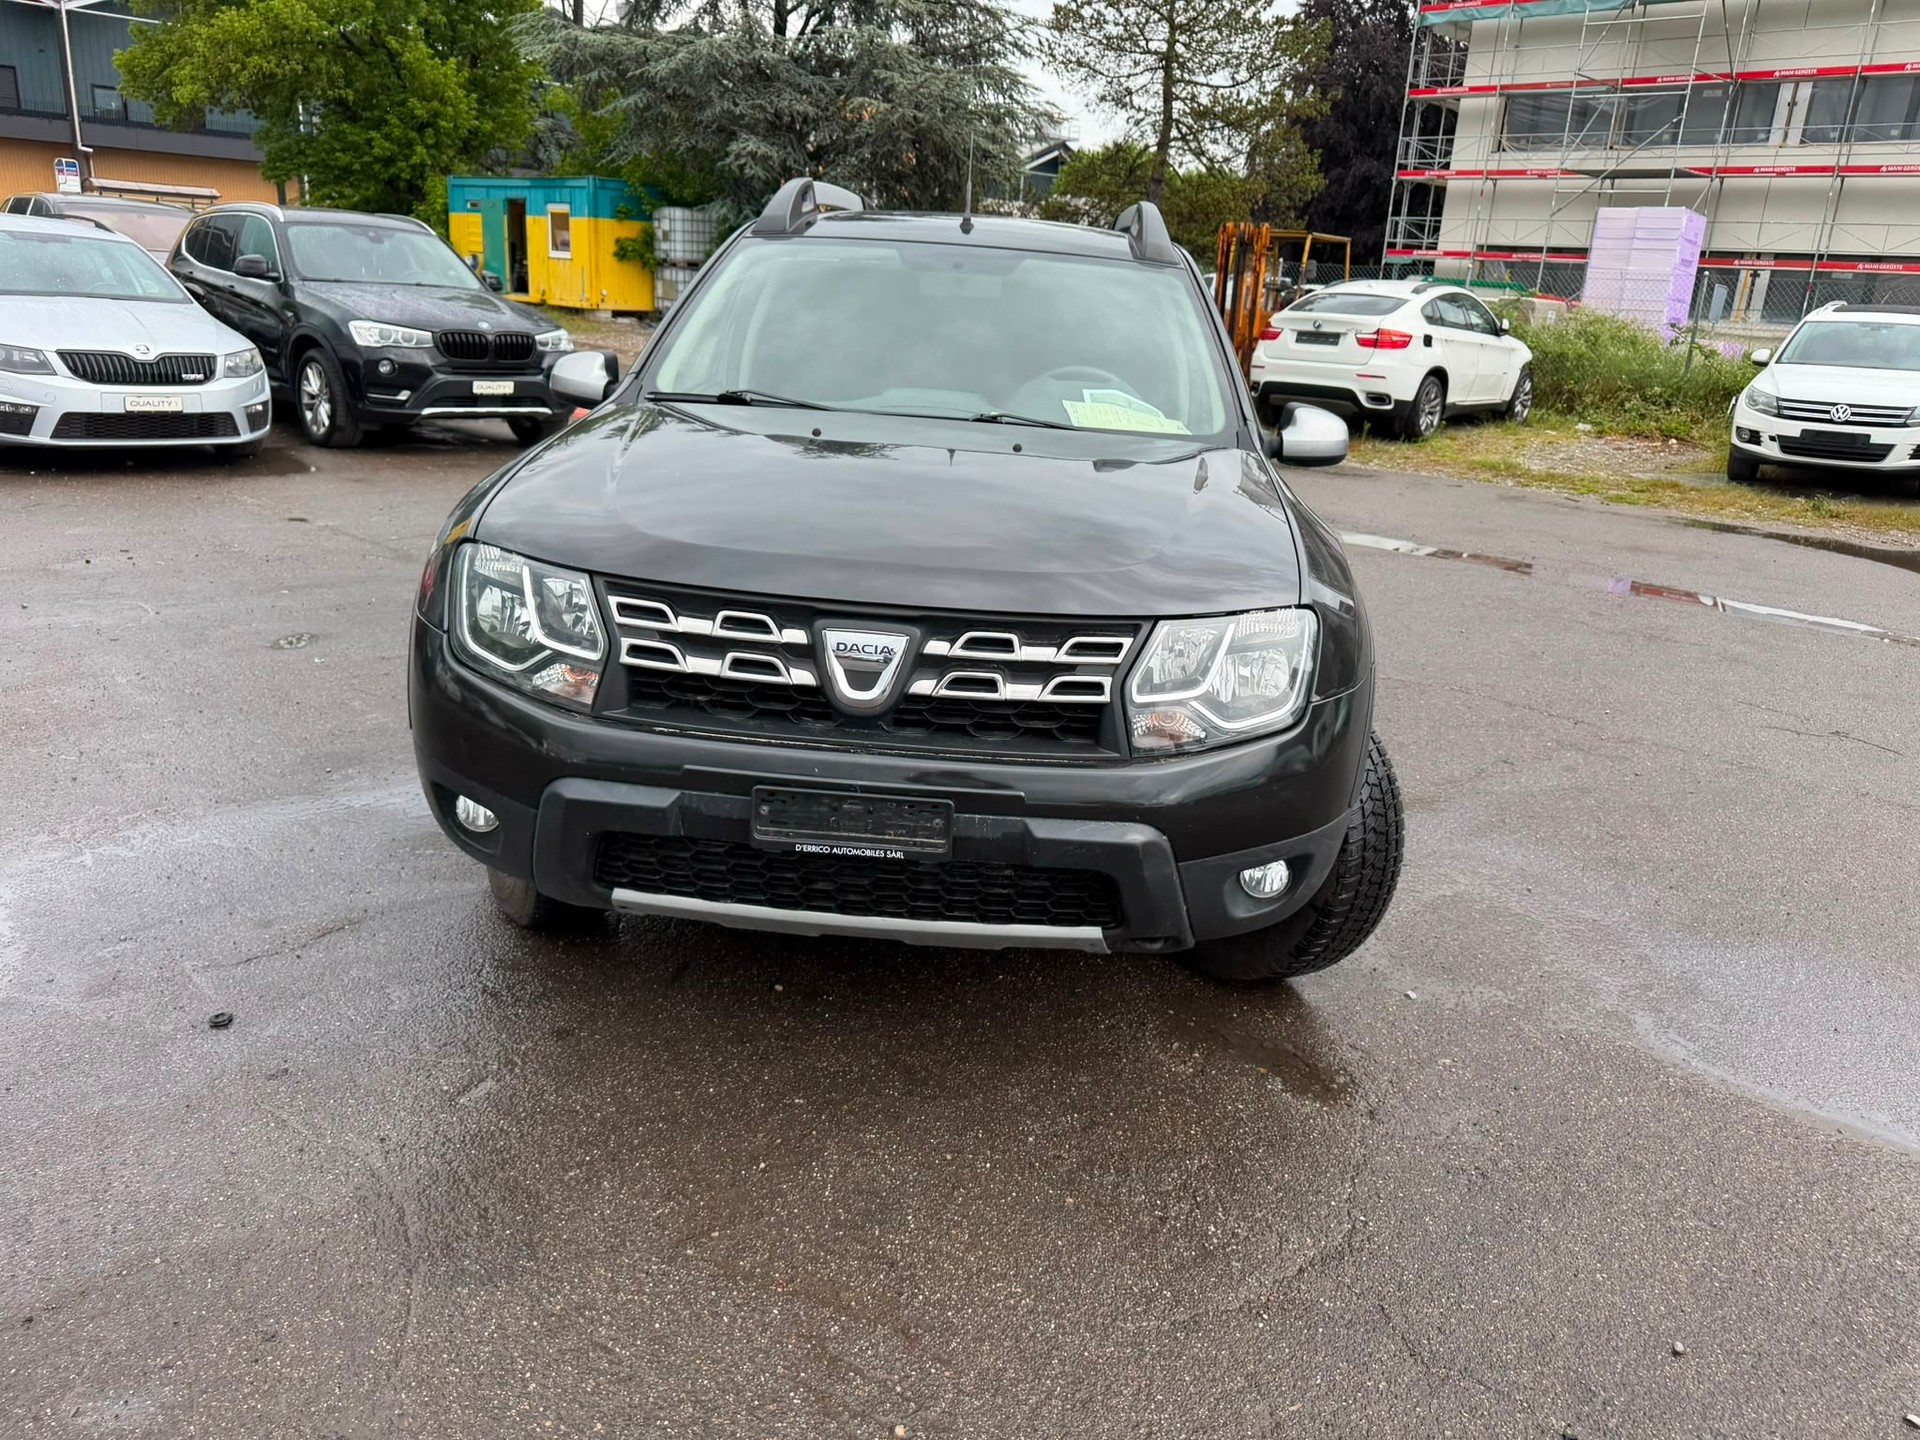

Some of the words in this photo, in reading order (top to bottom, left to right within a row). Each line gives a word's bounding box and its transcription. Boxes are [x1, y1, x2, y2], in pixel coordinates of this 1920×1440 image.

[836, 642, 892, 656] DACIA
[795, 844, 831, 854] D'ERRICO
[831, 847, 885, 858] AUTOMOBILES
